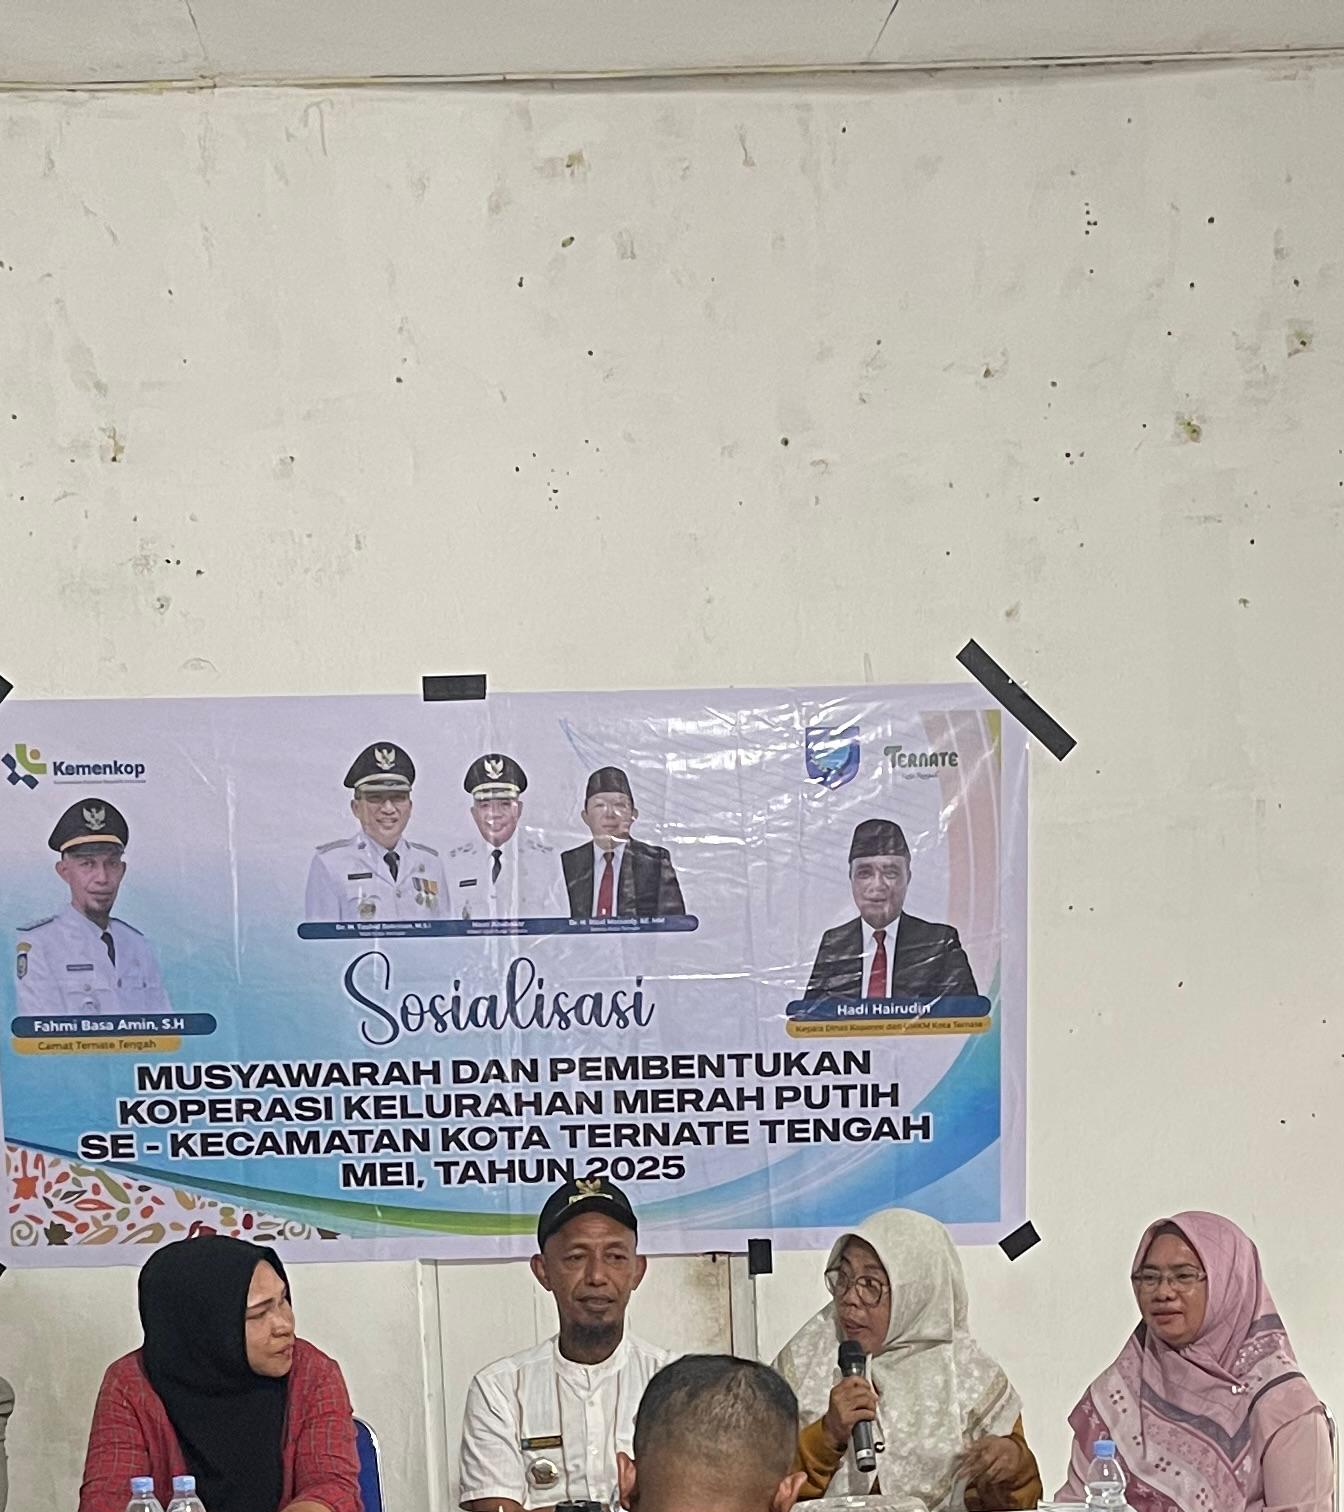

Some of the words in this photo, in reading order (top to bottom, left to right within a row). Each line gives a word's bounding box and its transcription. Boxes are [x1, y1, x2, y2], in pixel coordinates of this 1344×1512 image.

[53, 760, 145, 778] Kemenkop
[344, 951, 655, 1045] Sosialisasi
[837, 1004, 869, 1016] Hadi
[873, 1002, 931, 1016] Hairudin
[34, 1019, 77, 1032] Fahmi
[82, 1019, 113, 1031] Basa
[118, 1018, 158, 1032] Amin,
[162, 1018, 184, 1030] S.H
[38, 1041, 73, 1051] Camat
[76, 1040, 115, 1050] Ternate
[119, 1039, 157, 1051] Tengah
[136, 1059, 442, 1091] MUSYAWARAH
[451, 1058, 538, 1084] DAN
[549, 1050, 871, 1082] PEMBENTUKAN
[119, 1095, 333, 1126] KOPERASI
[344, 1091, 603, 1121] KELURAHAN
[613, 1086, 768, 1115] MERAH
[776, 1083, 899, 1111] PUTIH
[80, 1134, 135, 1160] SE
[170, 1128, 430, 1159] KECAMATAN
[441, 1125, 551, 1154] KOTA
[560, 1120, 749, 1149] TERNATE
[761, 1115, 931, 1144] TENGAH
[342, 1160, 424, 1189] MEI,
[434, 1158, 574, 1186] TAHUN
[585, 1156, 685, 1182] 2025
